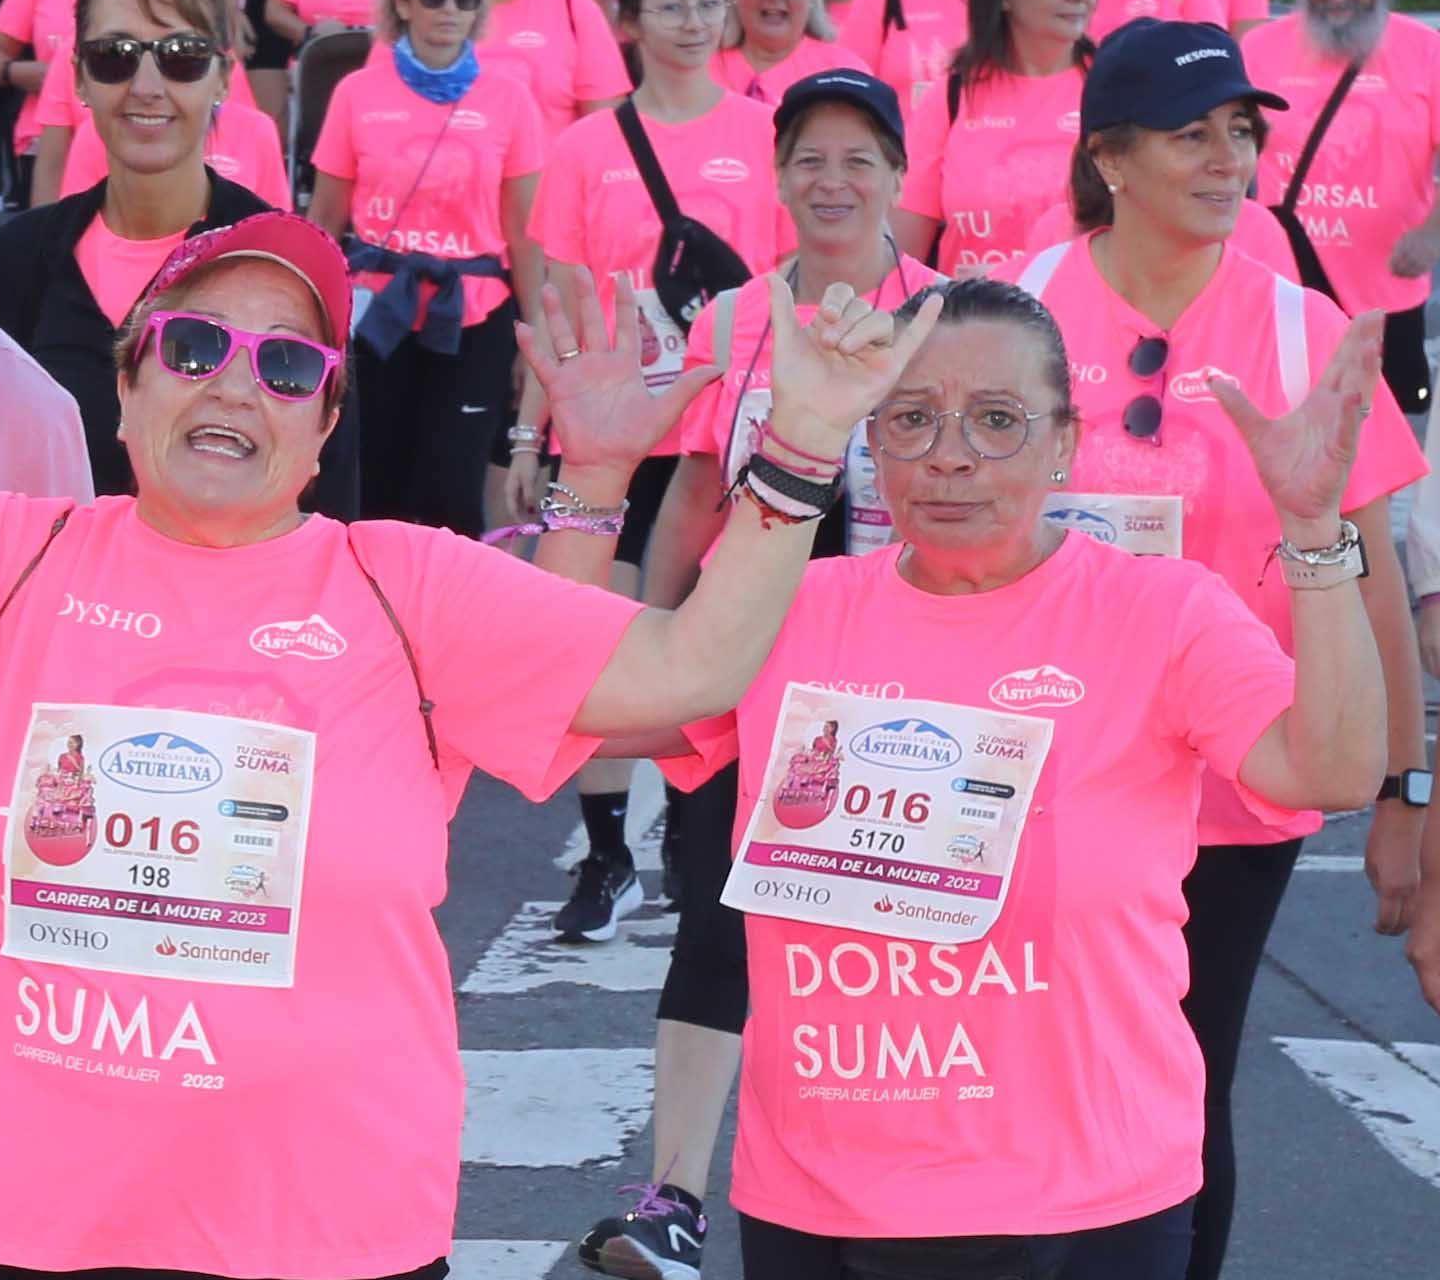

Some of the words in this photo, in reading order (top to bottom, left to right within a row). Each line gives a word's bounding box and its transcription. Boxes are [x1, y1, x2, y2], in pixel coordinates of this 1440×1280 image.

[952, 210, 993, 239] TU
[1301, 214, 1350, 239] MA
[256, 631, 339, 655] ASTRIANA
[995, 683, 1078, 701] ASTURIANA
[856, 734, 952, 764] ASTURIANA
[974, 741, 1026, 761] SUMA
[107, 751, 213, 782] ASTURIANA
[233, 754, 291, 775] SUMA
[843, 784, 933, 825] 016
[104, 812, 201, 856] 016
[849, 828, 906, 854] 5170
[127, 864, 171, 889] 198
[769, 849, 838, 870] CARRERA
[839, 857, 864, 872] DE
[864, 862, 885, 877] LA
[888, 864, 941, 886] MUJER
[943, 875, 982, 893] 2023
[753, 878, 832, 906] OYSHO
[35, 888, 111, 911] CARRERA
[113, 897, 139, 913] DE
[140, 901, 161, 916] LA
[165, 903, 223, 922] MUJER
[228, 910, 268, 926] 2023
[895, 900, 978, 927] Santander
[29, 922, 110, 951] OYSHO
[179, 941, 271, 965] Santander
[784, 940, 1050, 997] DORSAL
[15, 975, 218, 1066] SUMA
[792, 1022, 987, 1080] SUMA
[14, 1042, 63, 1067] CARRERA
[64, 1055, 86, 1072] DE
[86, 1059, 106, 1075] LA
[105, 1063, 161, 1084] MUJER
[181, 1072, 225, 1091] 2023
[798, 1085, 850, 1102] CARRERA
[851, 1087, 872, 1102] DE
[872, 1088, 893, 1103] LA
[893, 1086, 941, 1103] MUJER
[957, 1084, 996, 1102] 2023
